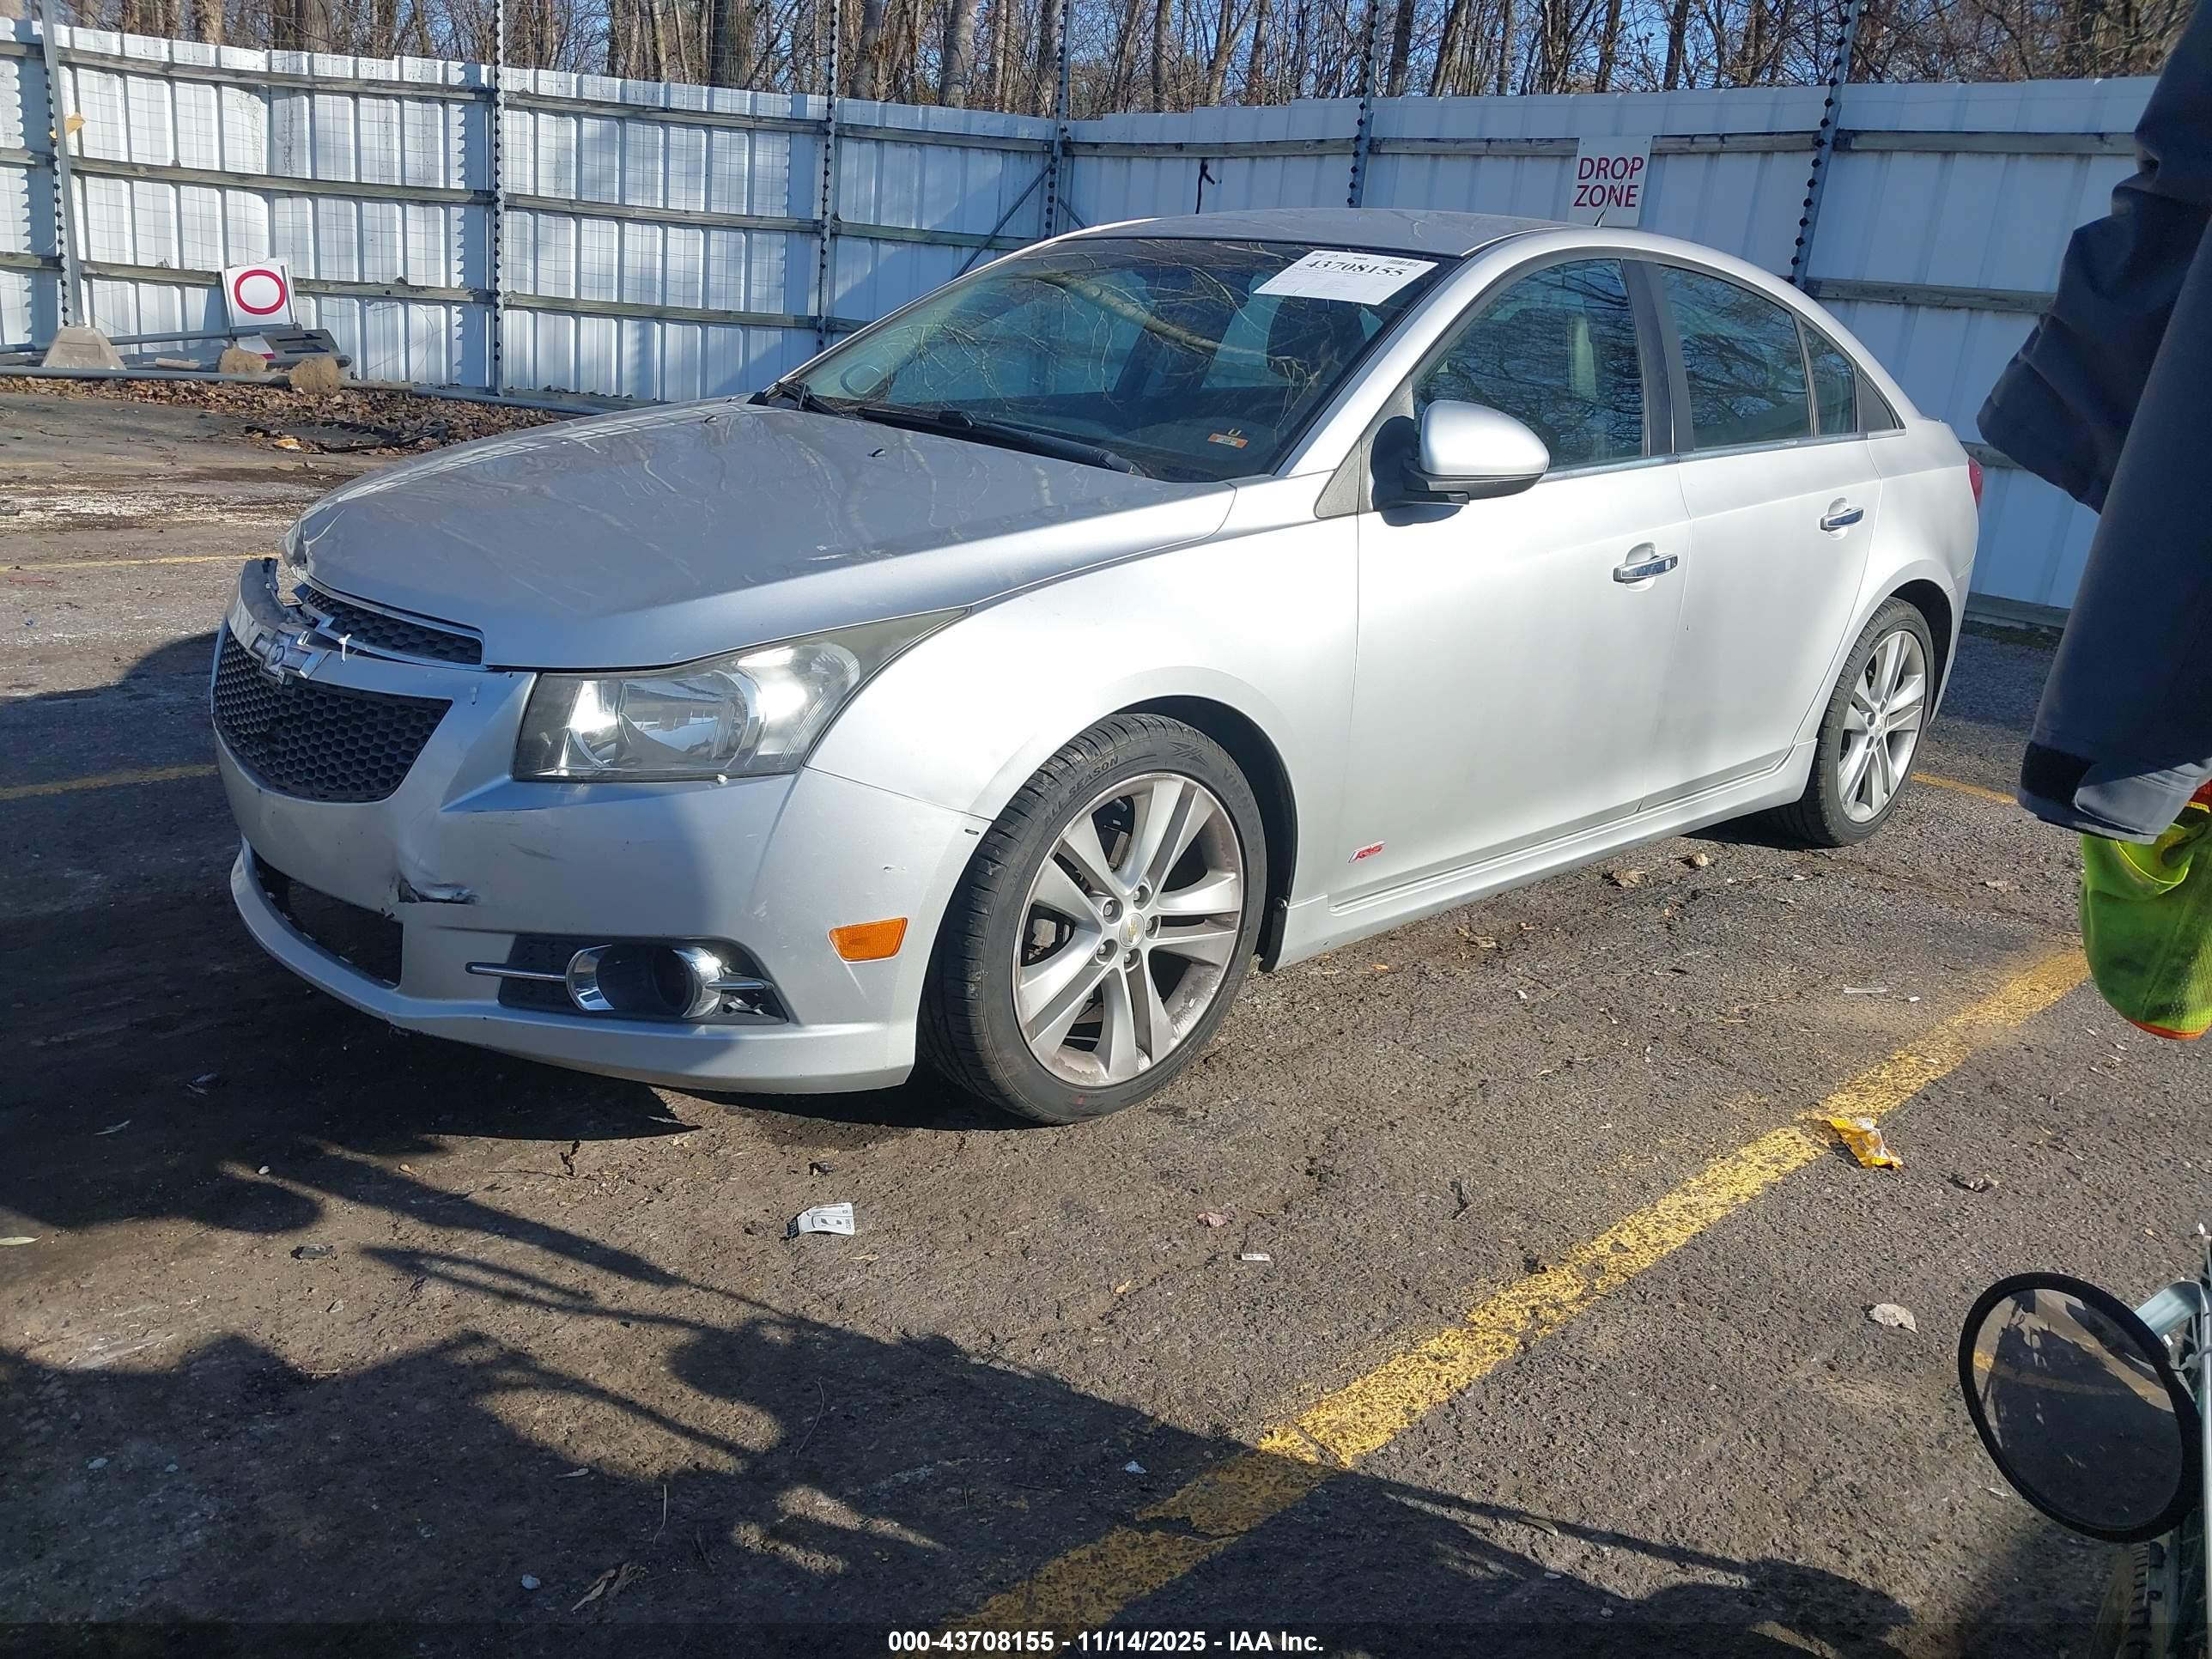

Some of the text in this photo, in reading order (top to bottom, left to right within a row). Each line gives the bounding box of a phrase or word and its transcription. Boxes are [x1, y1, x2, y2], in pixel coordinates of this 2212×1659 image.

[1577, 156, 1644, 179] DROP
[1573, 185, 1638, 207] ZONE
[1304, 259, 1409, 276] 43708155
[1068, 756, 1119, 795] SEASON
